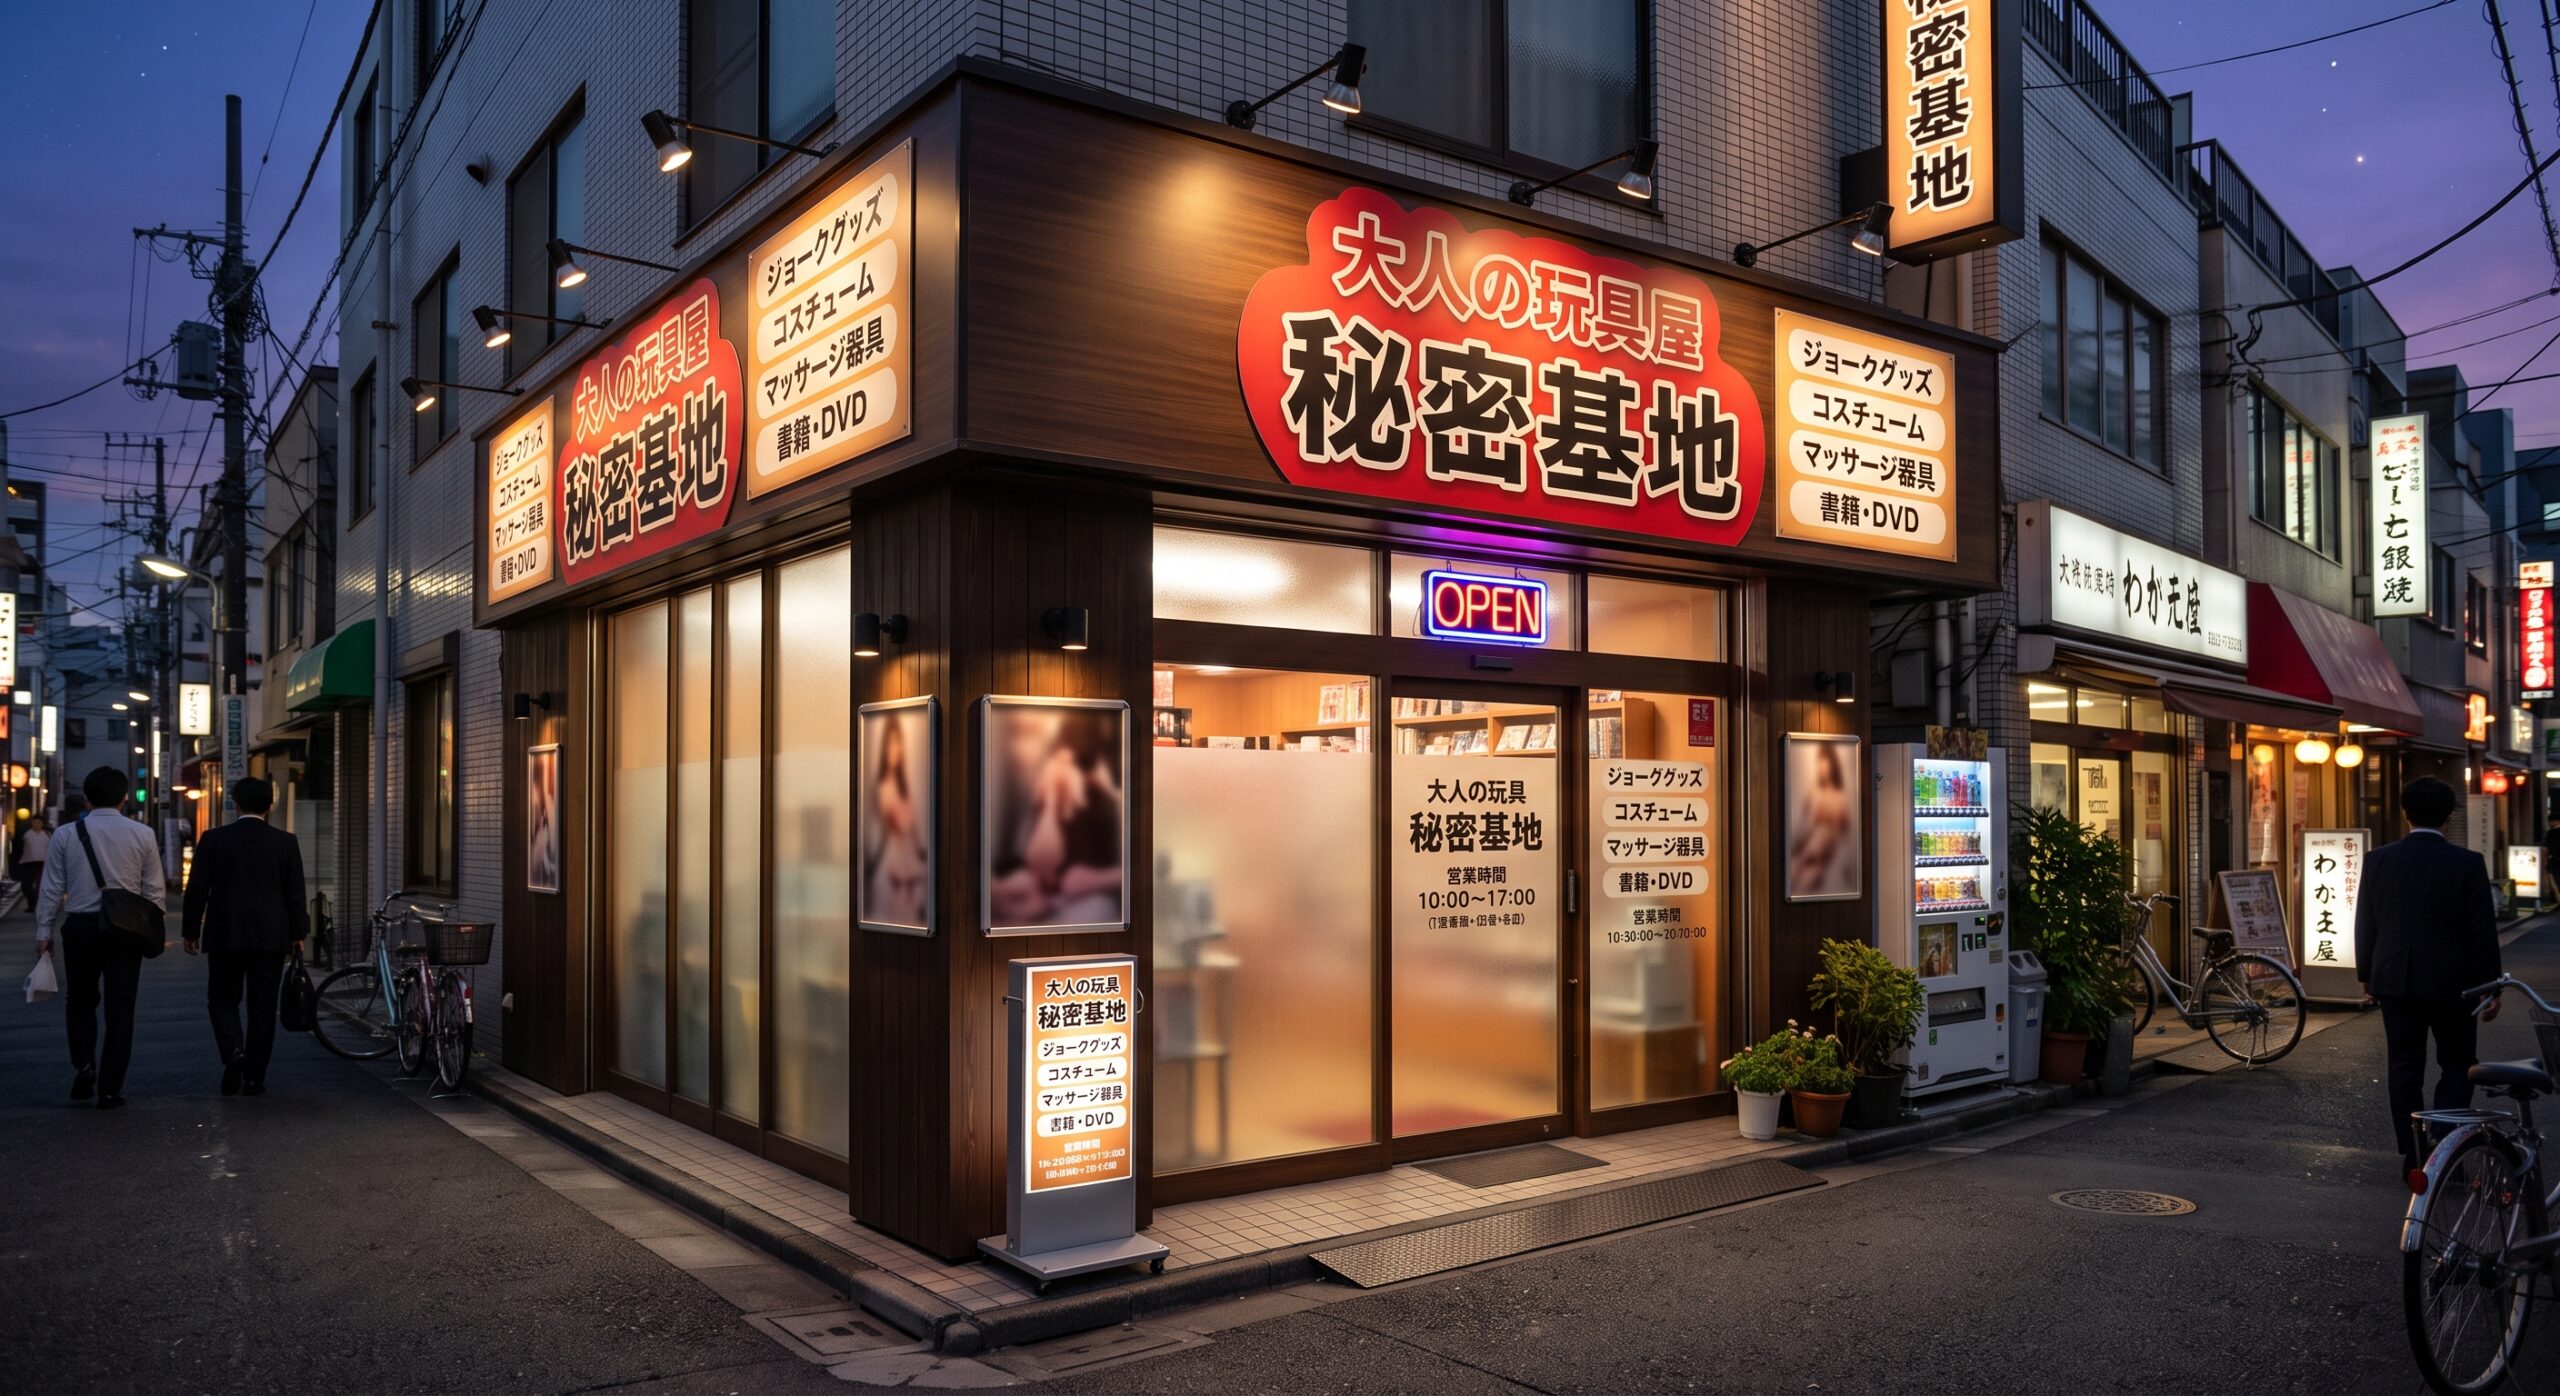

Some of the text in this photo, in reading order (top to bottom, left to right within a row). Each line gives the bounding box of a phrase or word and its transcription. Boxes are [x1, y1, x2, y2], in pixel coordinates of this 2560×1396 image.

[1906, 0, 1973, 212] 密基地
[767, 186, 884, 297] ジョークグッズ
[773, 261, 875, 347] コスチューム
[1331, 210, 1704, 372] 大人の玩具屋
[575, 294, 710, 444] 大人の玩具屋
[765, 315, 885, 407] マッサージ器具
[1803, 339, 1932, 397] ジョークグッズ
[776, 389, 867, 463] 書籍・DVD
[1281, 309, 1742, 522] 秘密基地
[1813, 392, 1925, 442] コスチューム
[500, 465, 541, 508] コスチューム
[563, 376, 728, 565] 秘密基地
[1803, 440, 1936, 492] マッサージ器具
[1820, 491, 1919, 533] 書籍・DVD
[1433, 581, 1541, 636] OPEN
[1427, 778, 1526, 804] 大人の玩具
[1615, 802, 1697, 822] コスチューム
[1410, 811, 1543, 853] 秘密基地
[1607, 836, 1705, 857] マッサージ器具
[1447, 866, 1506, 885] 営業時間
[1046, 976, 1120, 997] 大人の玩具
[1038, 1000, 1126, 1029] 秘密基地
[1042, 1036, 1121, 1057] ジョークグッズ
[1042, 1085, 1123, 1107] マッサージ器具
[1048, 1062, 1117, 1082] コスチューム
